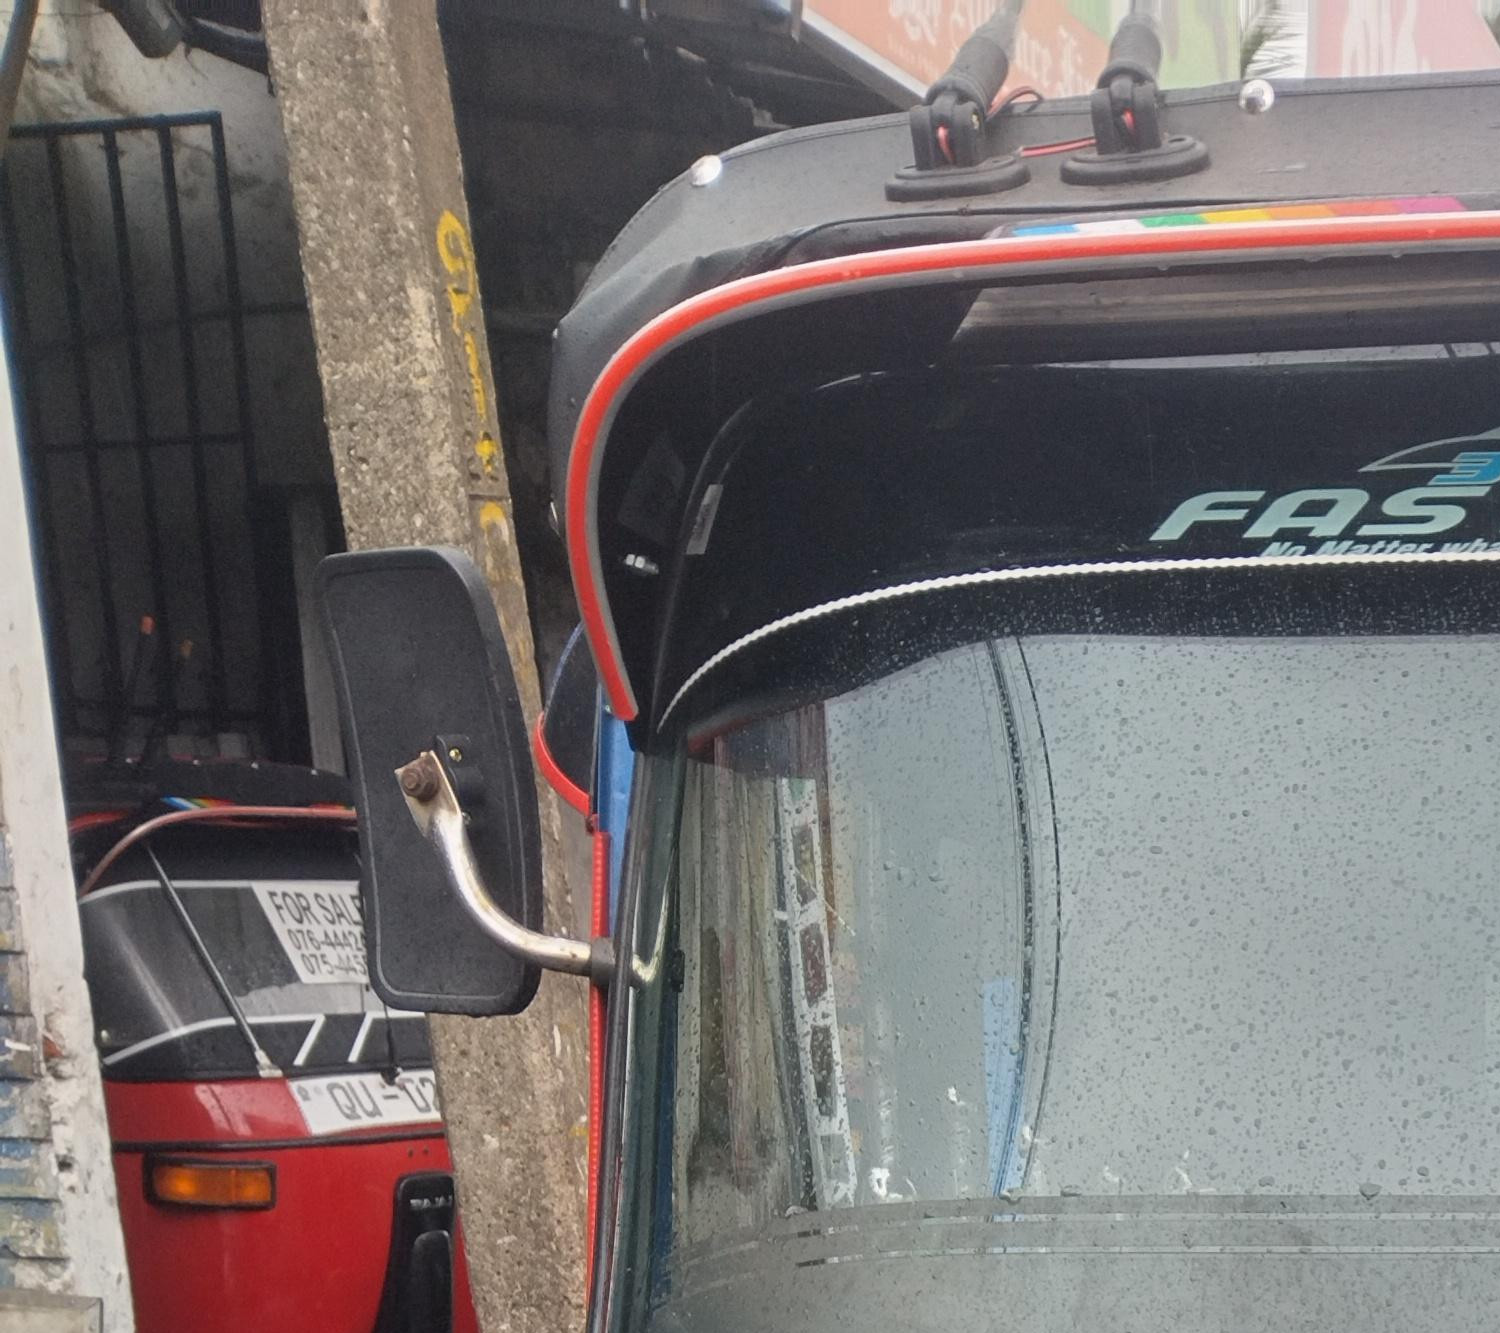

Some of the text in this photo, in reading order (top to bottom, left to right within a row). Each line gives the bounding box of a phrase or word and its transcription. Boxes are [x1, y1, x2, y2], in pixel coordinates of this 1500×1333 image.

[1261, 542, 1306, 557] No
[1314, 540, 1433, 556] Matter
[268, 891, 320, 925] FOR
